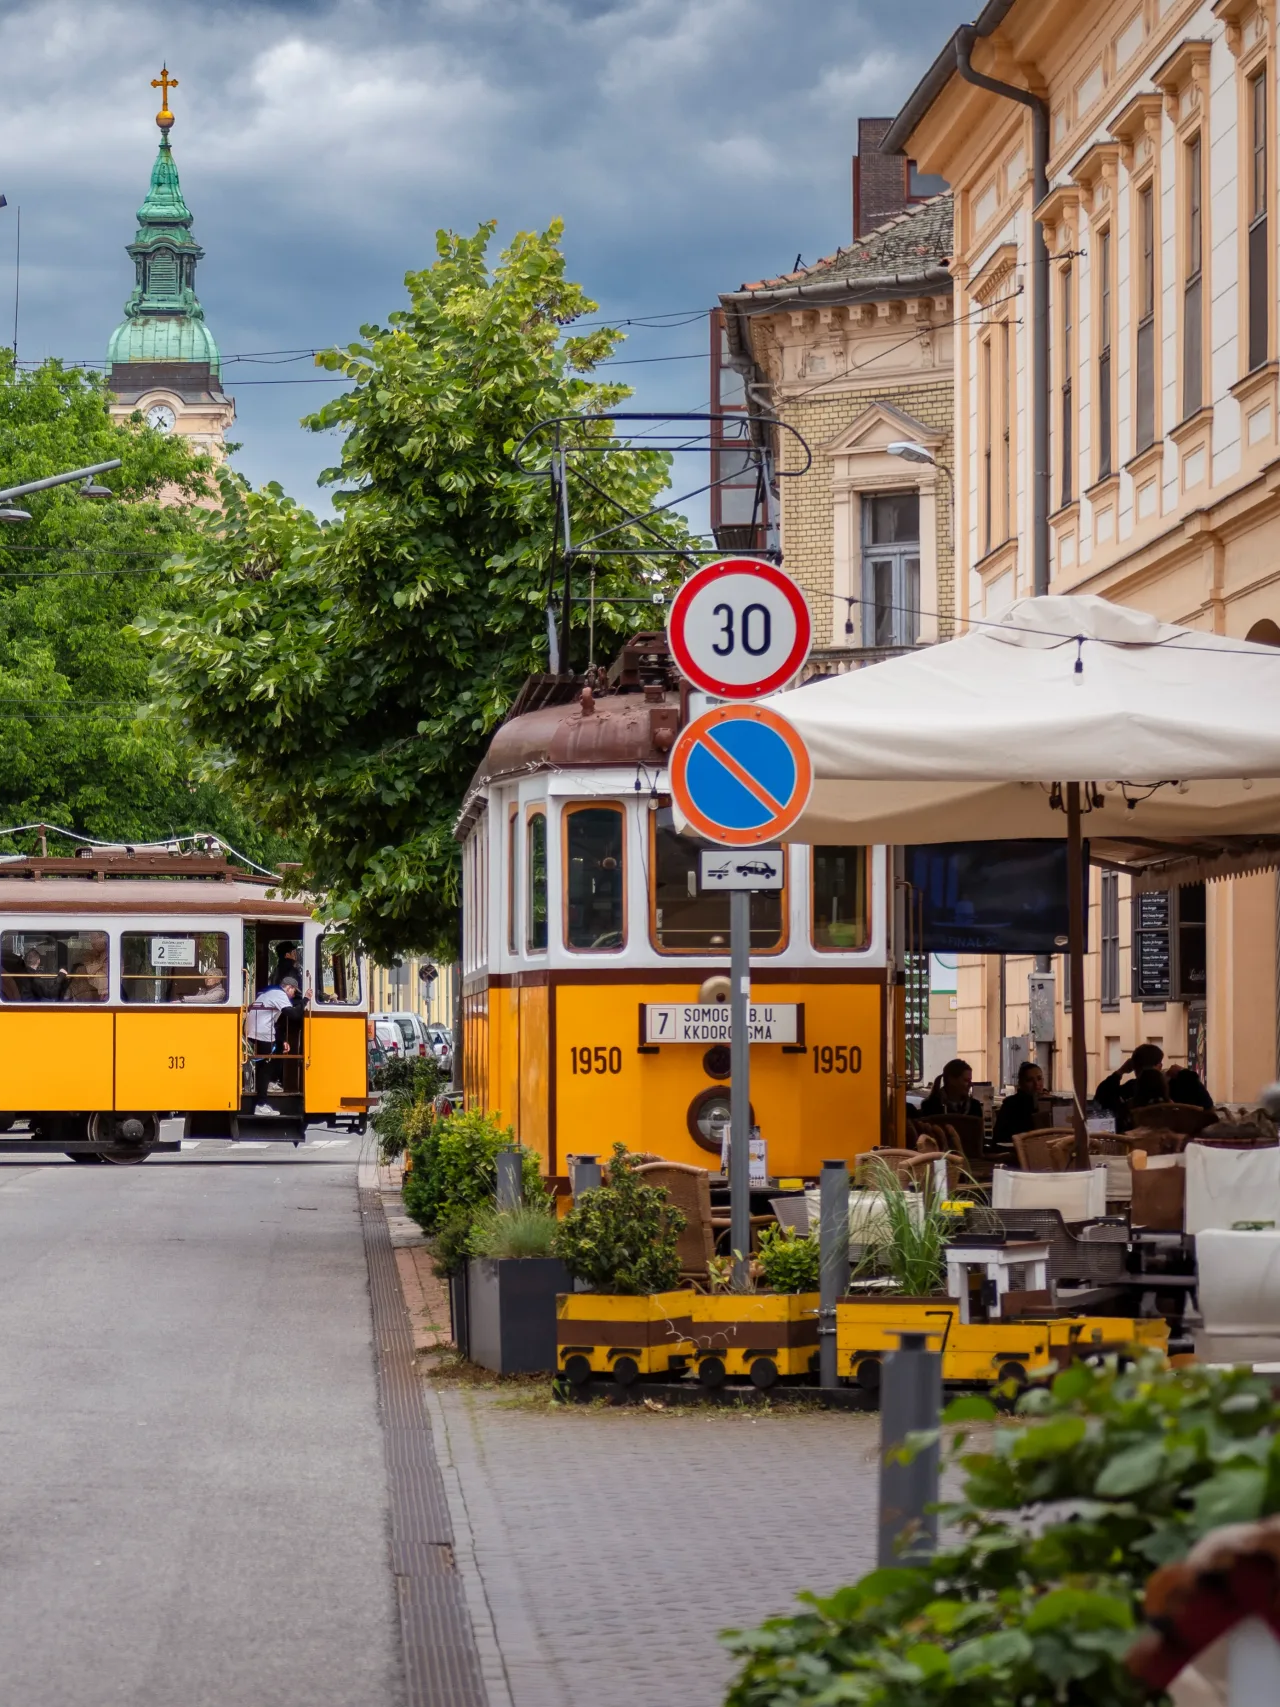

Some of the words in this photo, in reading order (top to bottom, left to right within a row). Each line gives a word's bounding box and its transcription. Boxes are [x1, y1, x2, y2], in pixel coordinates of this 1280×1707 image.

[712, 603, 771, 656] 30
[158, 946, 165, 959] 2
[658, 1013, 669, 1035] 7
[684, 1008, 732, 1022] SOMOG
[764, 1008, 776, 1022] U.
[168, 1055, 185, 1069] 313
[571, 1046, 622, 1075] 1950
[813, 1045, 862, 1074] 1950
